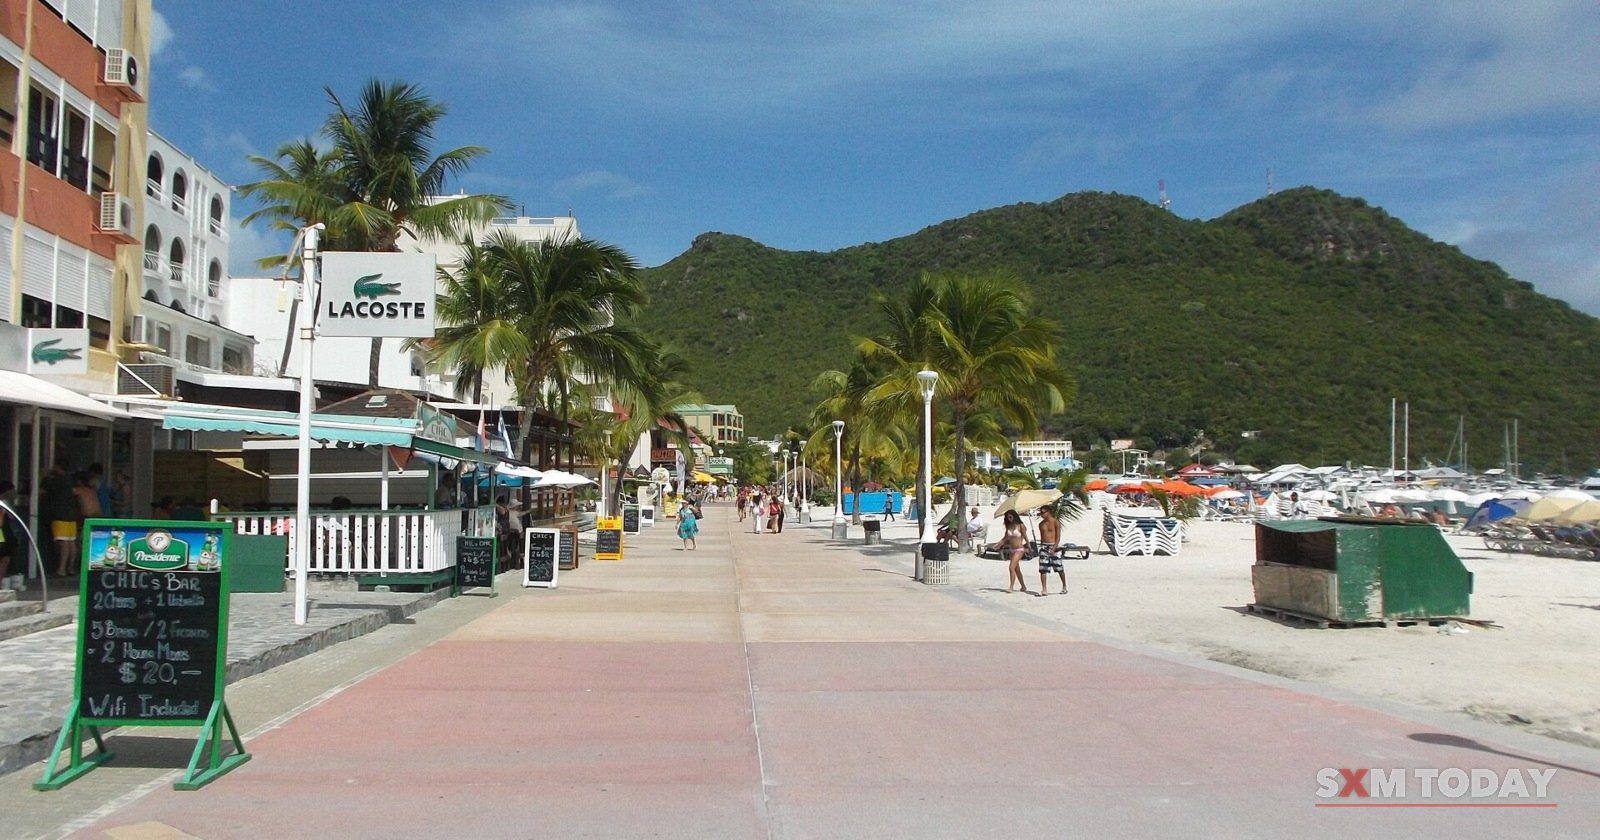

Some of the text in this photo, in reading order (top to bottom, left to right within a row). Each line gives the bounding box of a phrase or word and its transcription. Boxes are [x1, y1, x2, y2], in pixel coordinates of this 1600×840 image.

[329, 301, 425, 318] LACOSTE
[134, 550, 181, 562] Presidente
[101, 571, 201, 592] CHIC's BAR
[88, 694, 200, 717] Wifi Included
